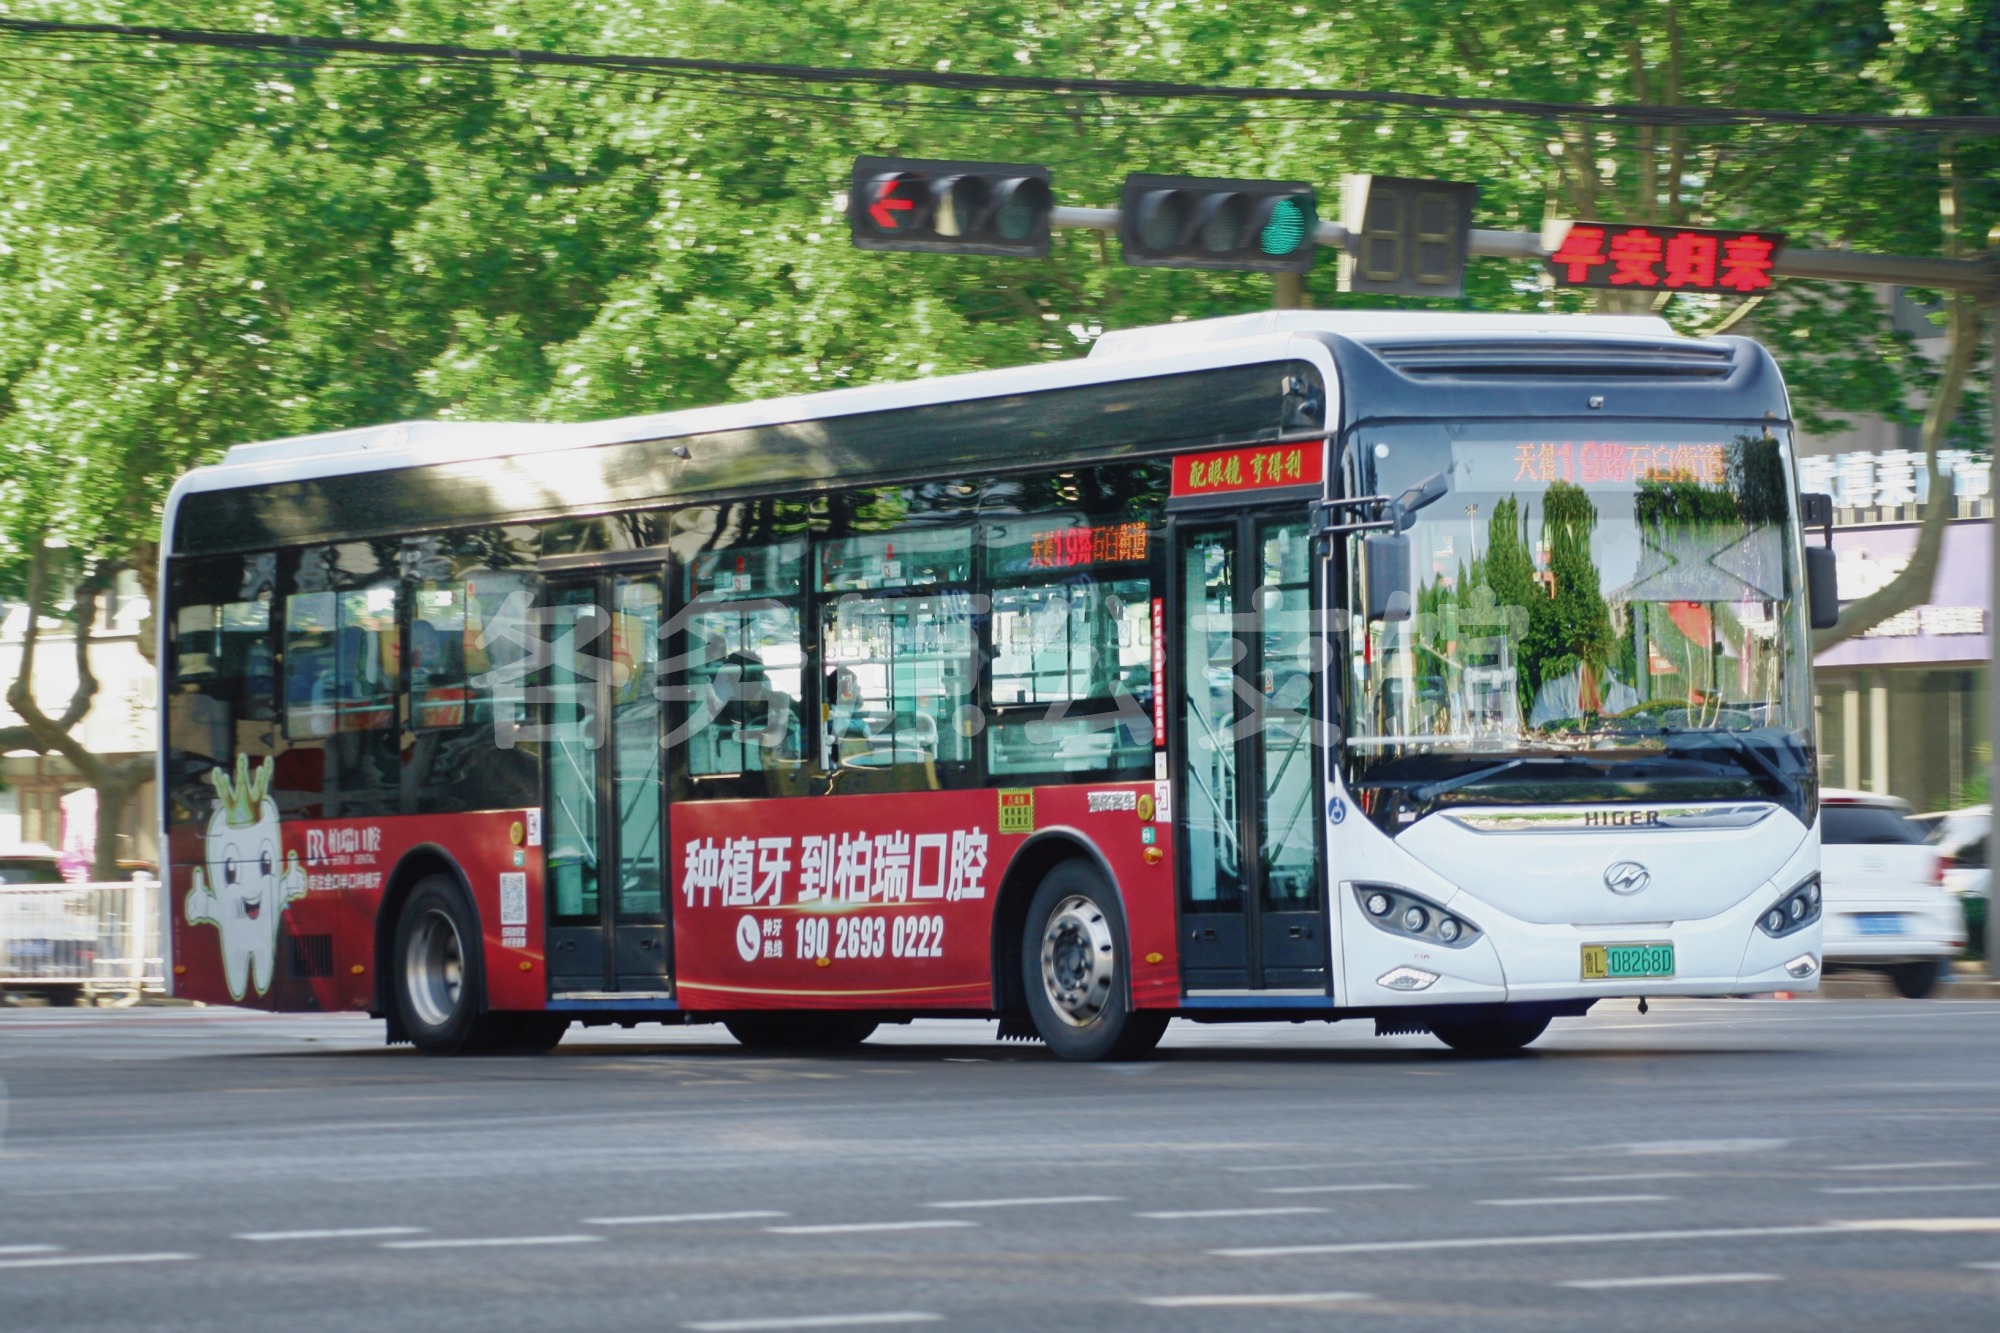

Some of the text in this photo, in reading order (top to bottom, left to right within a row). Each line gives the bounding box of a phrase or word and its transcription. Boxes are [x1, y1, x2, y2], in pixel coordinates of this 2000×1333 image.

[1552, 228, 1773, 291] 平安归来
[1190, 449, 1301, 488] 配眼镜 亨得利
[1585, 810, 1660, 826] HIGER
[682, 827, 988, 907] 种植牙 到柏瑞口腔
[763, 919, 782, 936] 种牙
[796, 915, 944, 959] 190 2693 0222
